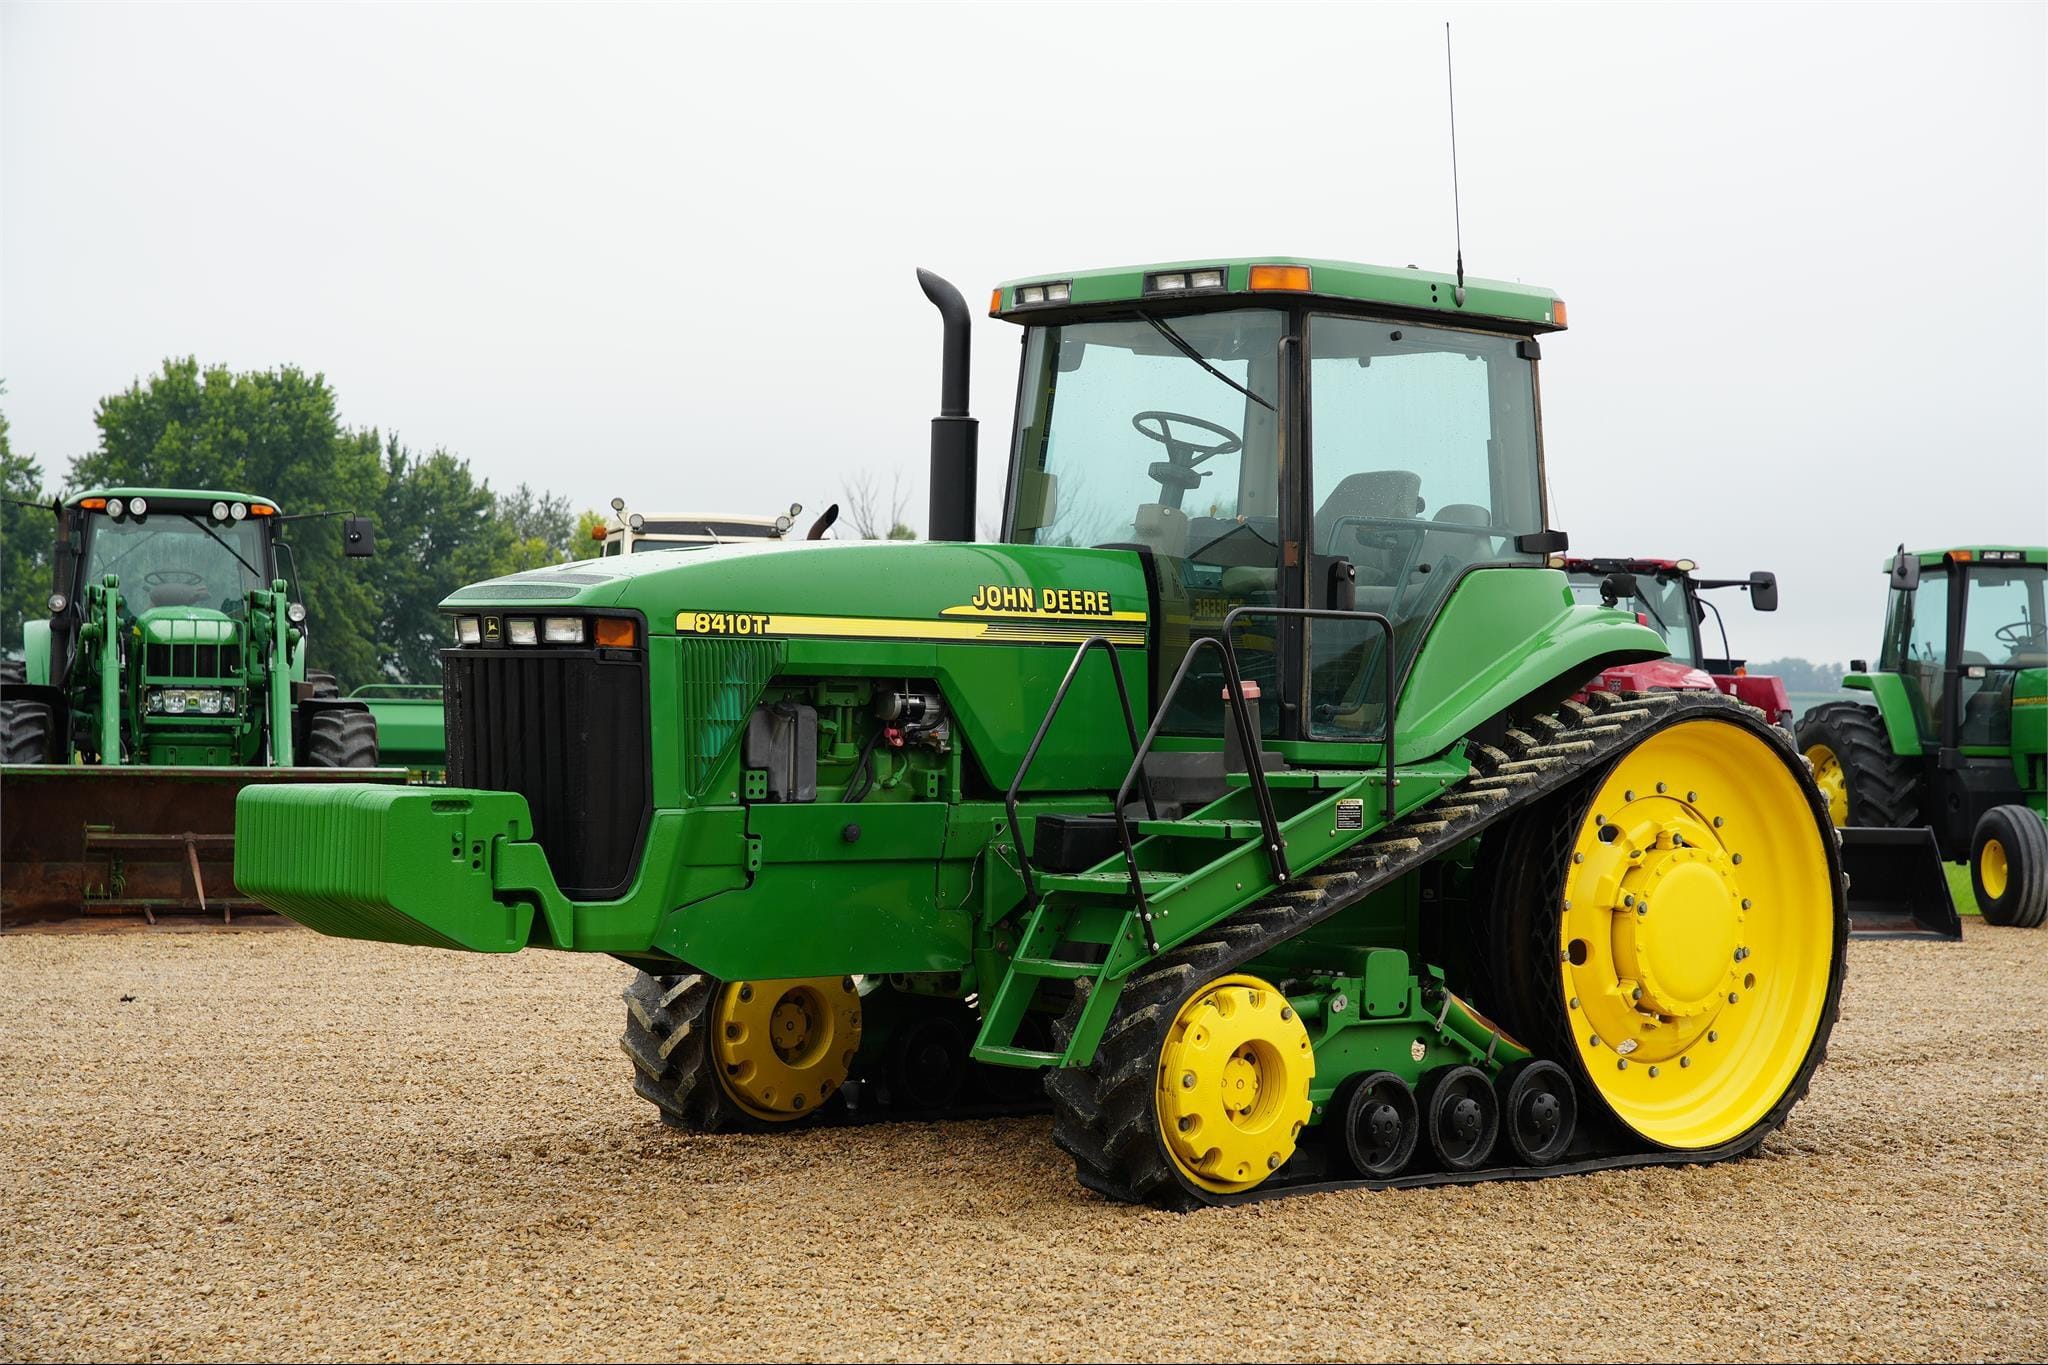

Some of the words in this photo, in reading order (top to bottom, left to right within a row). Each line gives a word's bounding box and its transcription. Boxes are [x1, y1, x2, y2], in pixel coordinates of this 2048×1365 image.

[972, 585, 1036, 611] JOHN
[1042, 588, 1112, 614] DEERE
[695, 612, 768, 634] 8410T
